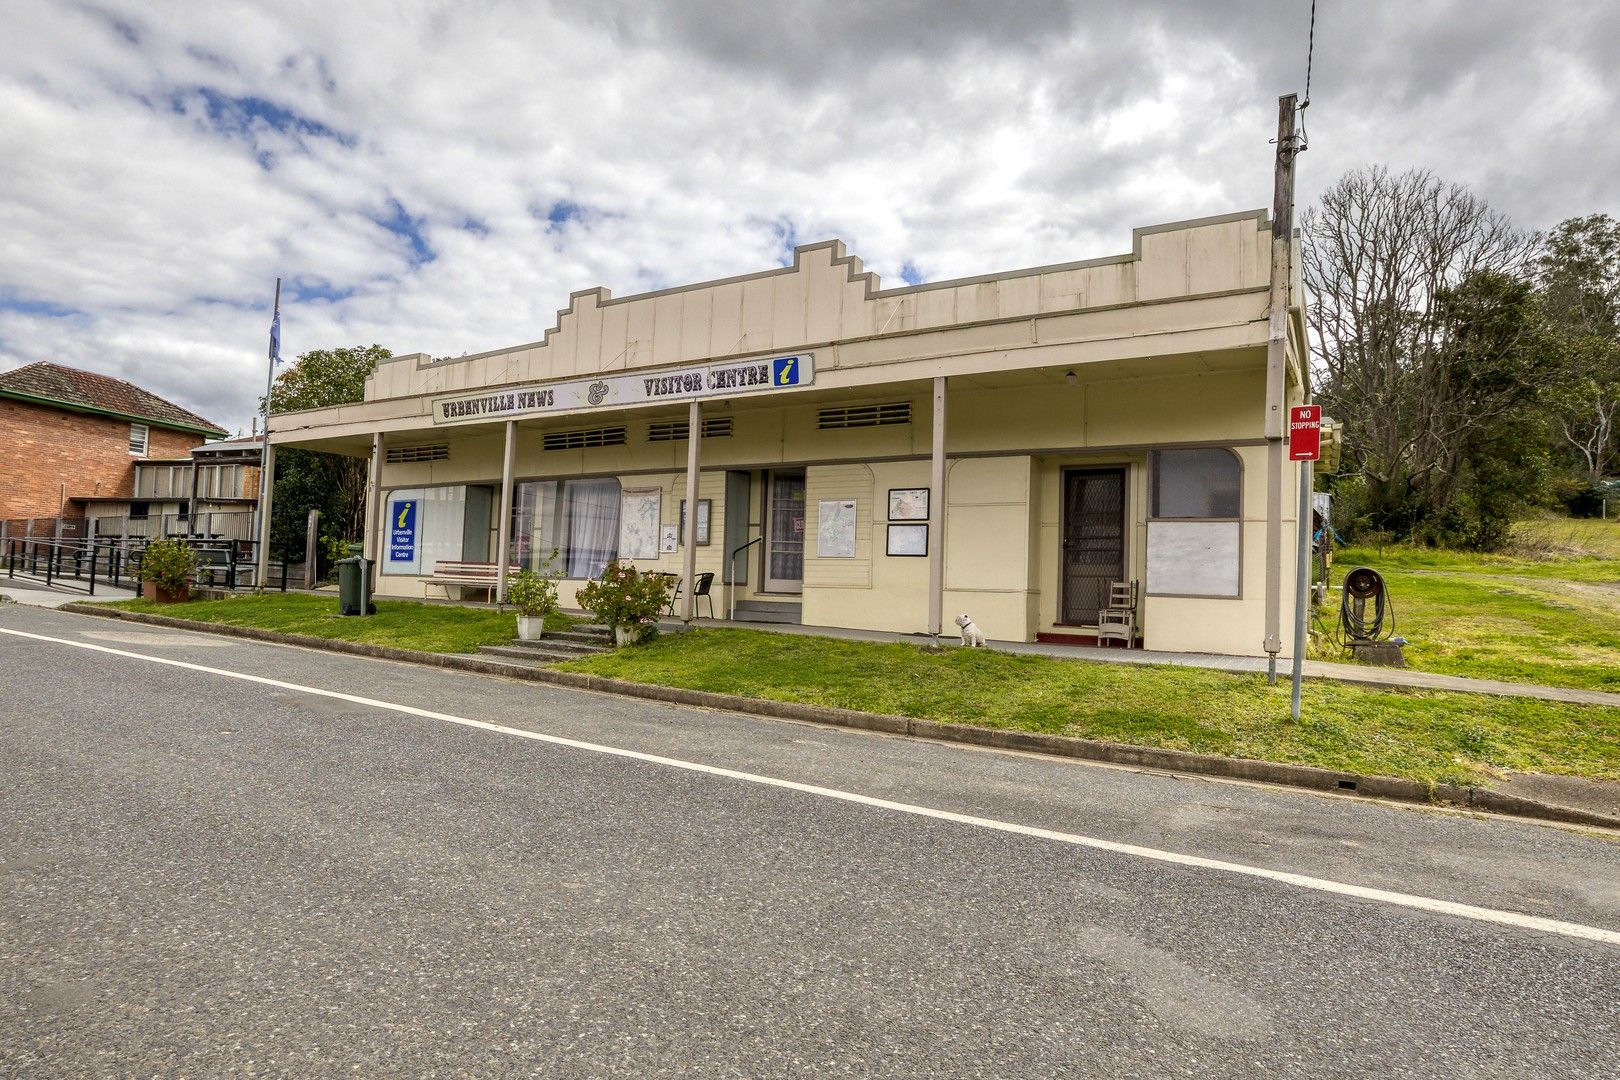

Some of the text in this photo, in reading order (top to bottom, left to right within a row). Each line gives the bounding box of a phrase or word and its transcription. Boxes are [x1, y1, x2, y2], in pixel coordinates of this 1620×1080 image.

[441, 365, 769, 418] URBENVILLE NEWS & VISITOR CENTRE
[1300, 410, 1311, 419] NO
[1291, 421, 1319, 429] STOPPING
